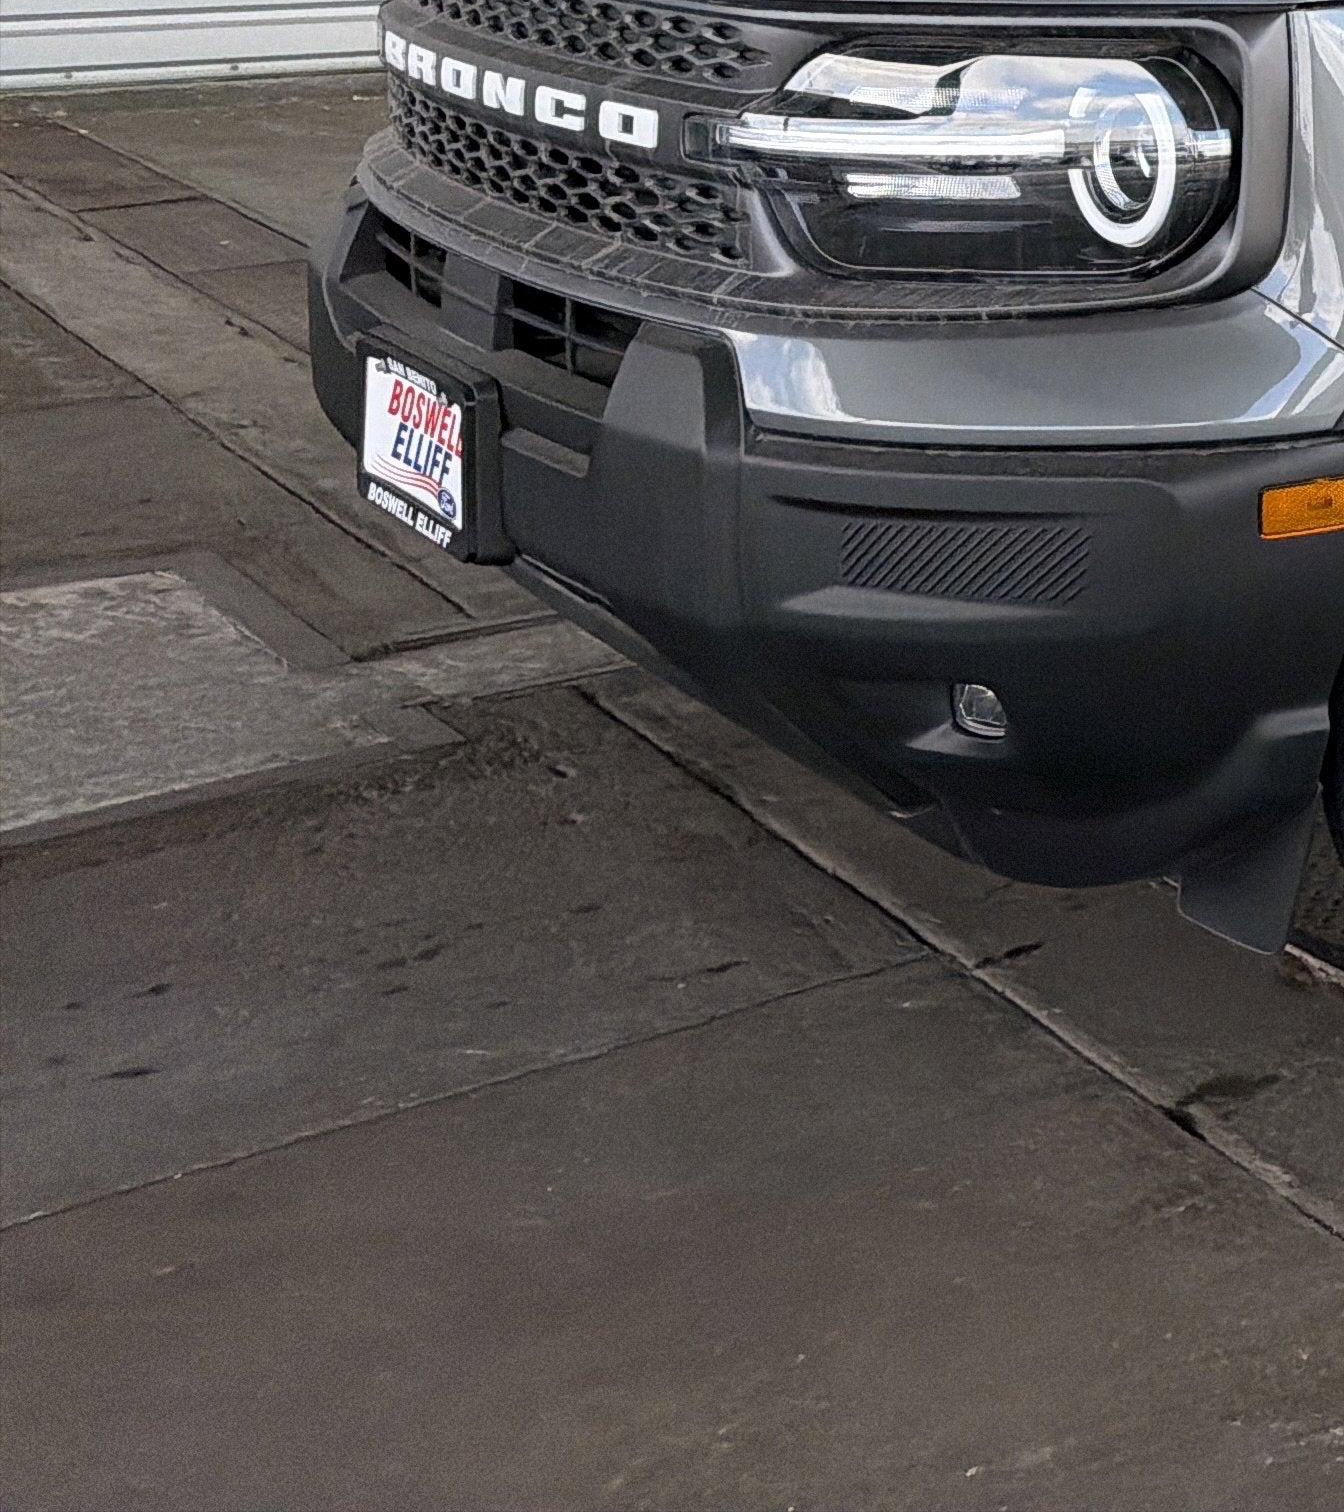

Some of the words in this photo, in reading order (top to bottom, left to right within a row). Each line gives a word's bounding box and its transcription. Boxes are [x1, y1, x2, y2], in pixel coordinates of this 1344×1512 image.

[385, 30, 659, 148] BRONCO
[391, 422, 452, 487] ELLIFF
[367, 482, 414, 526] BOSWELL
[415, 511, 453, 548] ELLIFF
